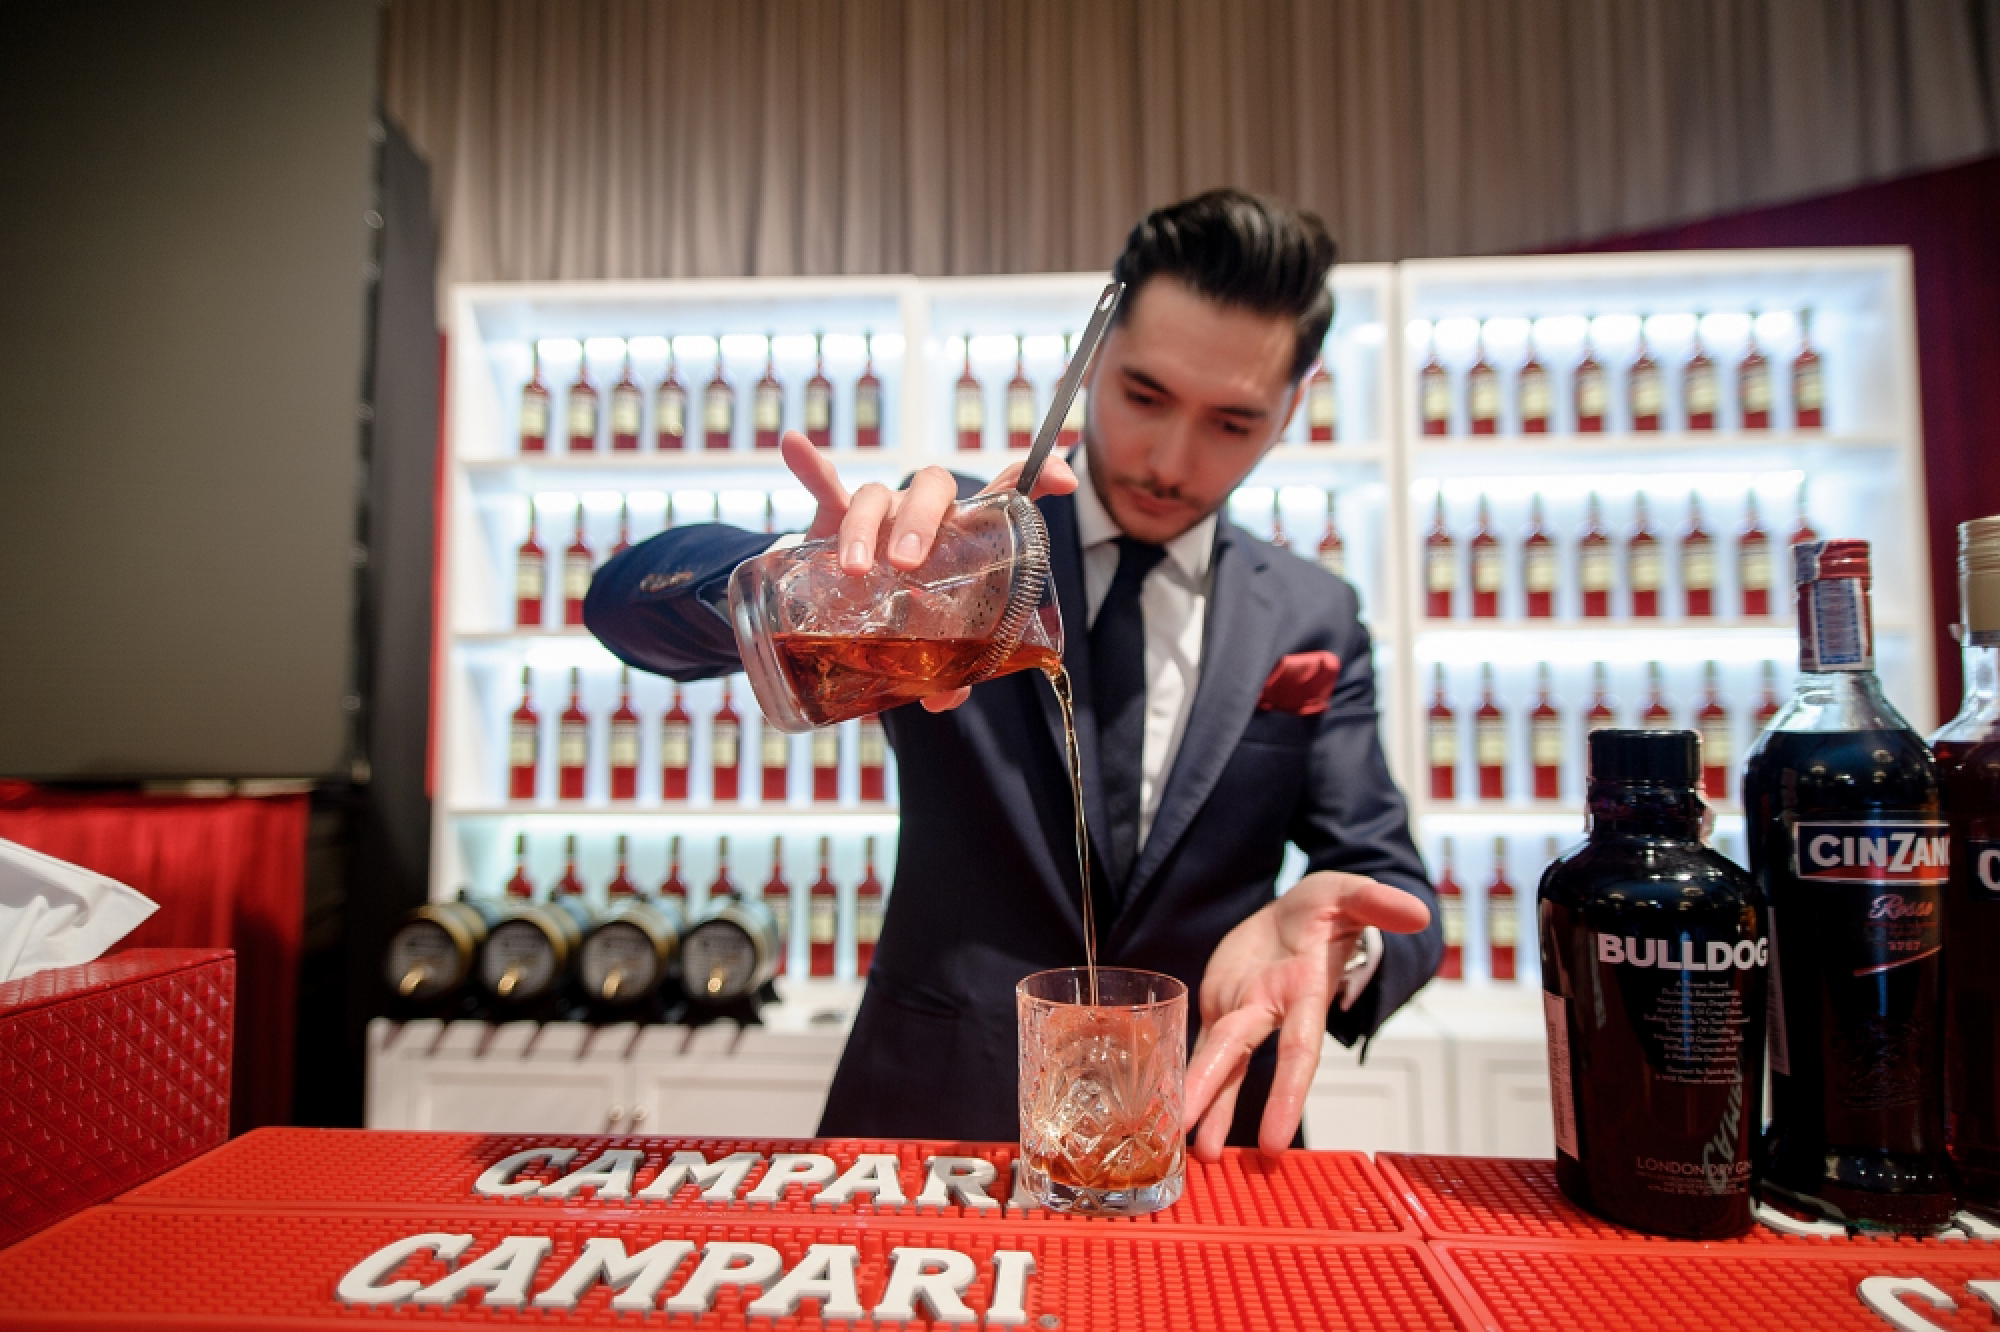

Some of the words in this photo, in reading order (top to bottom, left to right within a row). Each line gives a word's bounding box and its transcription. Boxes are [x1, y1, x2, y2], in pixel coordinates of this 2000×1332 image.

[1808, 831, 1950, 873] CINZAN
[1597, 932, 1768, 971] BULLDOG
[1636, 1156, 1705, 1175] LONDON
[335, 1233, 1036, 1326] CAMPARI
